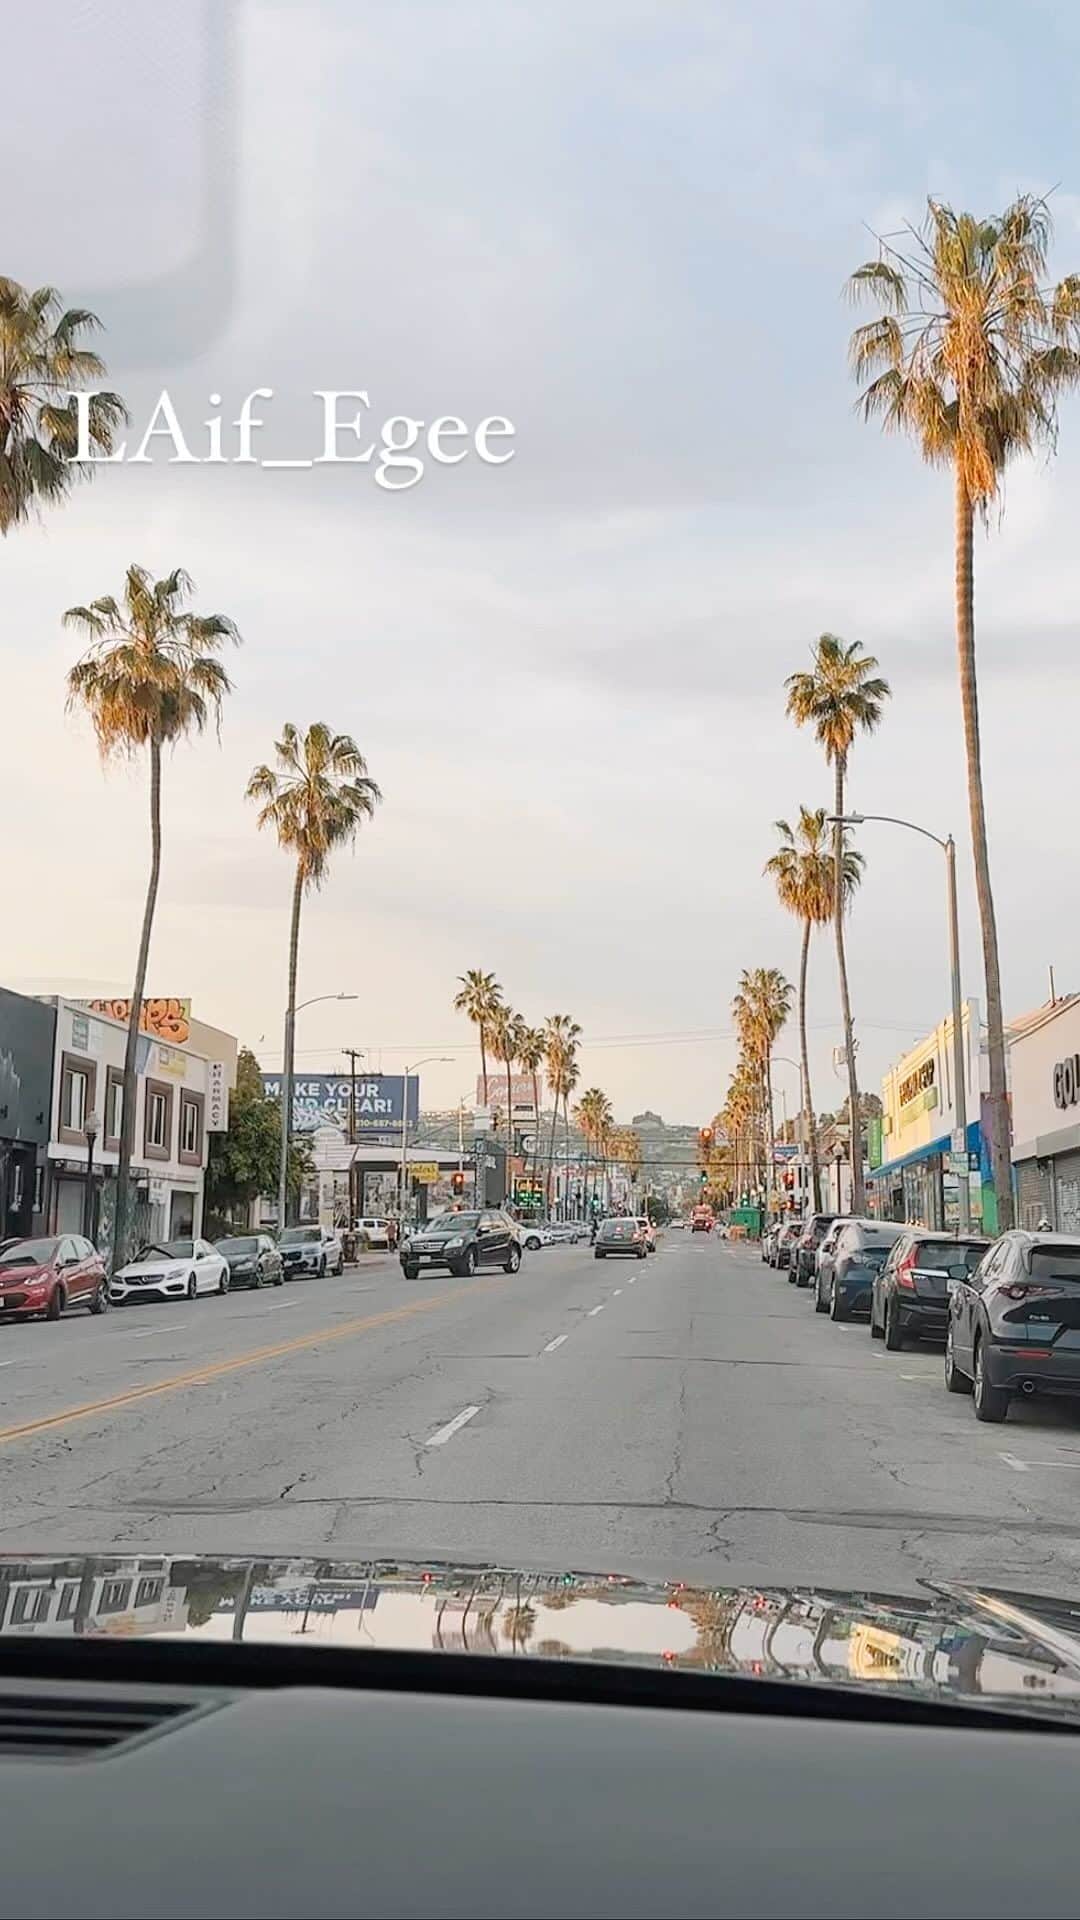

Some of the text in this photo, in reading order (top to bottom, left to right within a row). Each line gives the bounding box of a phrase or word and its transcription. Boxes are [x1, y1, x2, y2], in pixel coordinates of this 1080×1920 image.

[264, 1082, 379, 1097] MKE YOUR
[323, 1098, 393, 1113] CLEAR!
